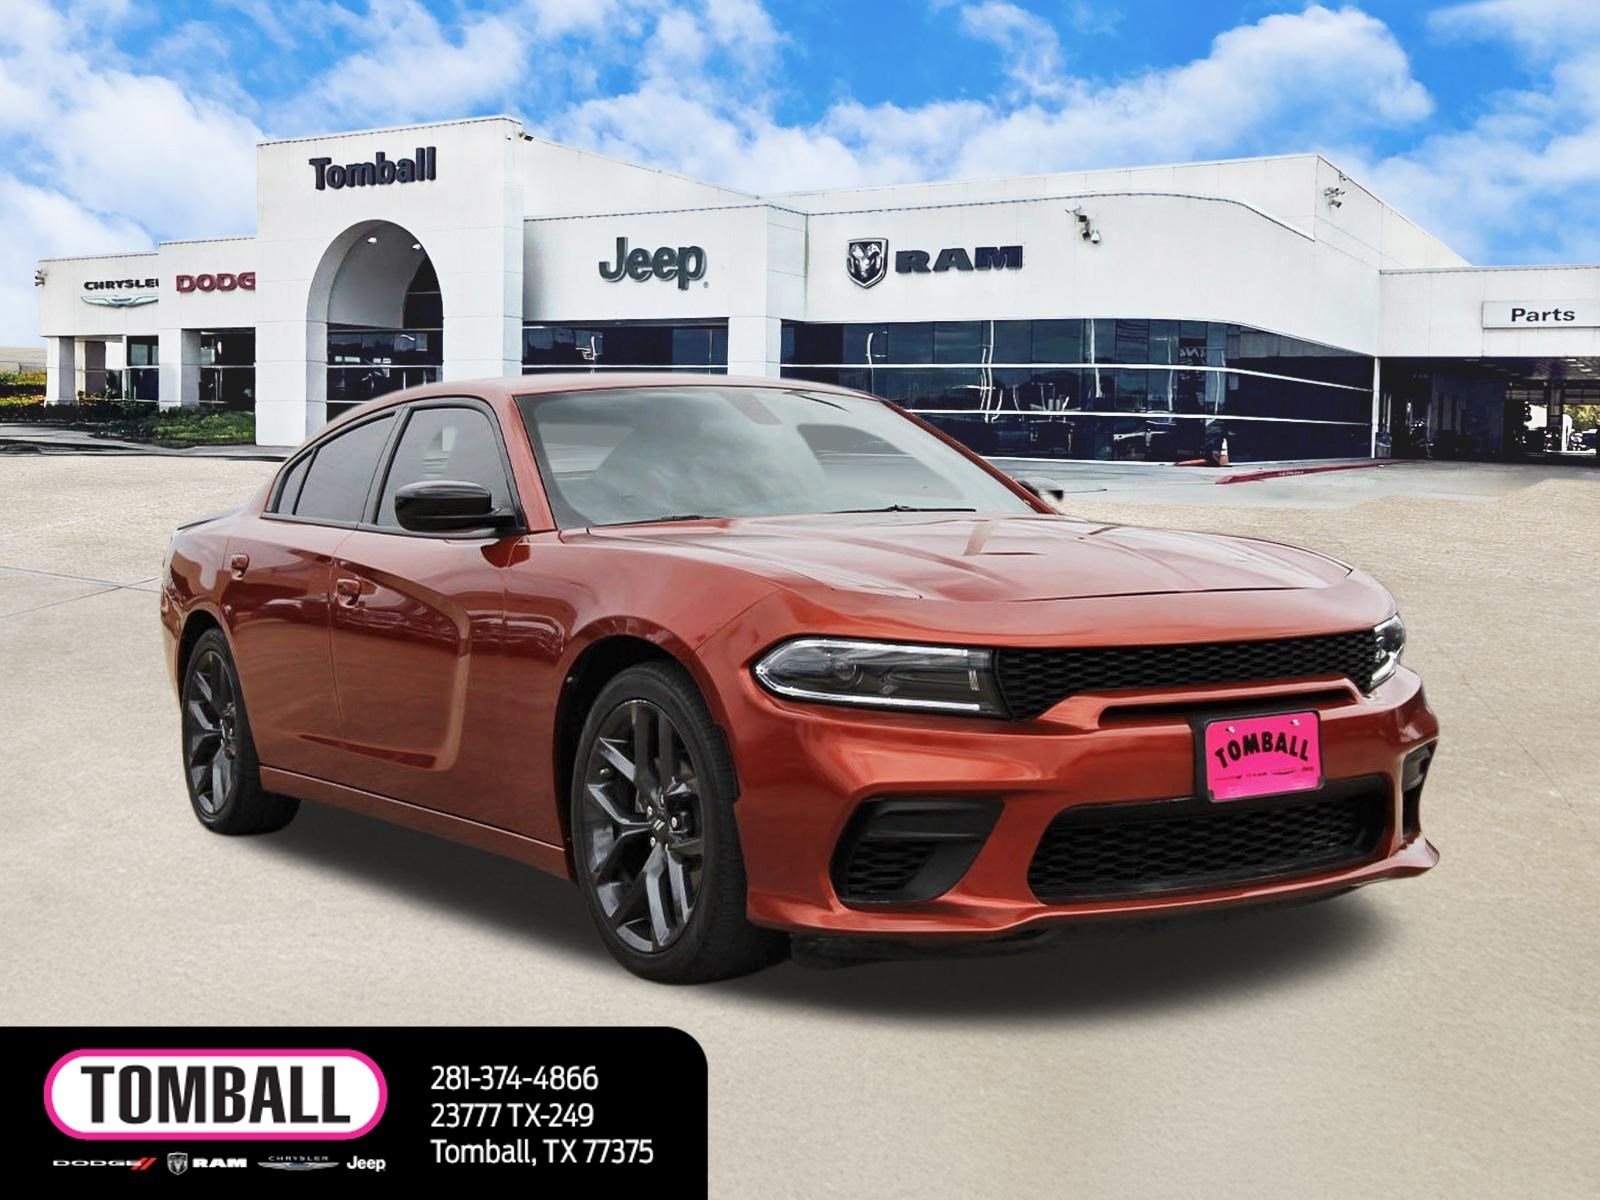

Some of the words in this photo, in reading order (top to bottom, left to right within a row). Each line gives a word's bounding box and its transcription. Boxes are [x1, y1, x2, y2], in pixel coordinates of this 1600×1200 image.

[308, 146, 437, 190] Tomball
[598, 236, 708, 291] Jeep
[895, 245, 1023, 274] RAM
[1511, 307, 1576, 323] Parts
[1214, 731, 1308, 769] TOMBALL
